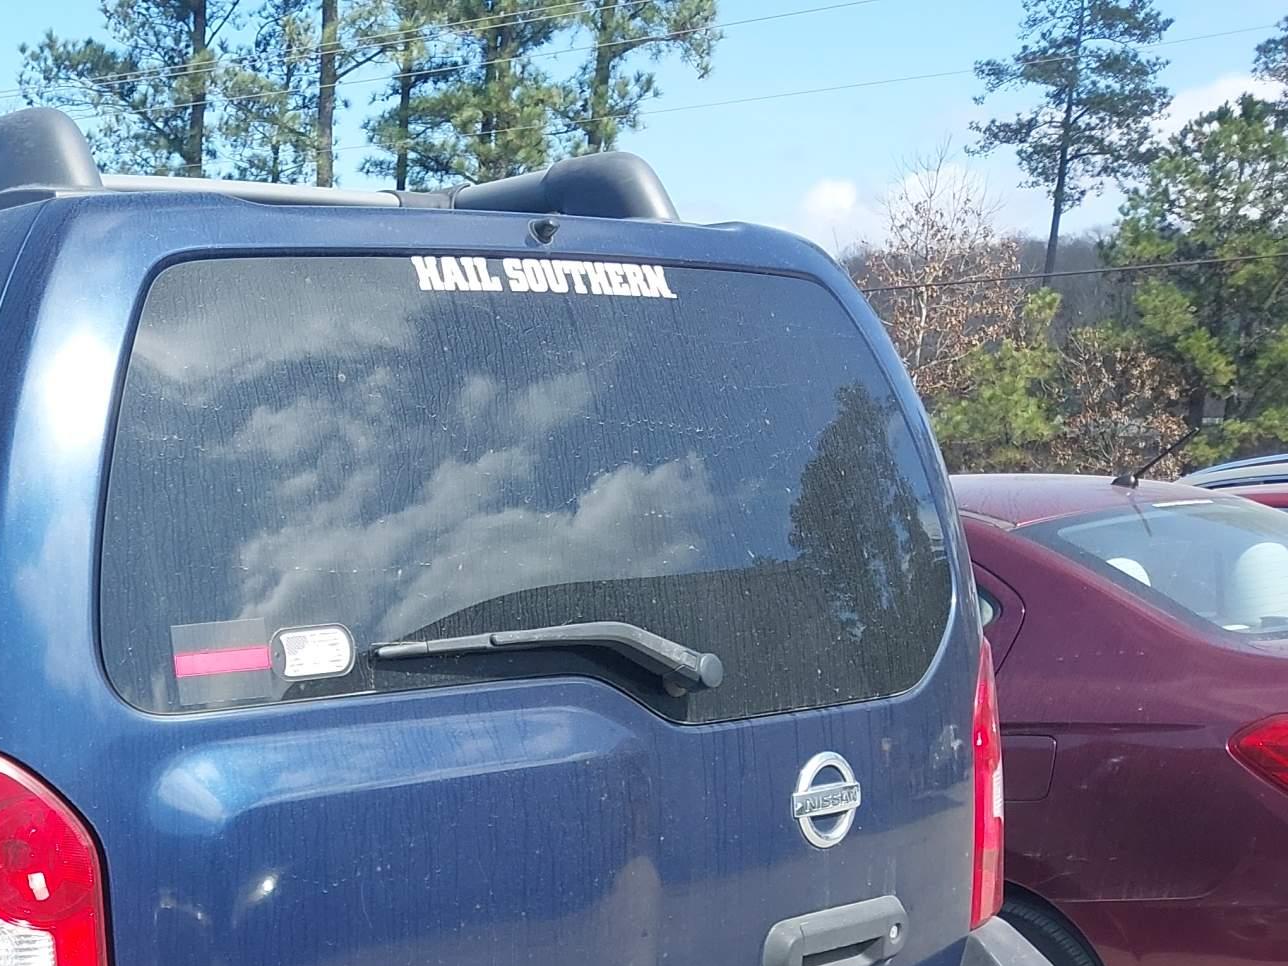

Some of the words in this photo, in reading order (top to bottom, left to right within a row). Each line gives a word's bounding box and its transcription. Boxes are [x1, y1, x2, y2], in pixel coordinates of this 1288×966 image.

[411, 256, 503, 291] HAIL
[503, 258, 677, 298] SOUTHERN
[804, 786, 858, 812] NISSAN
